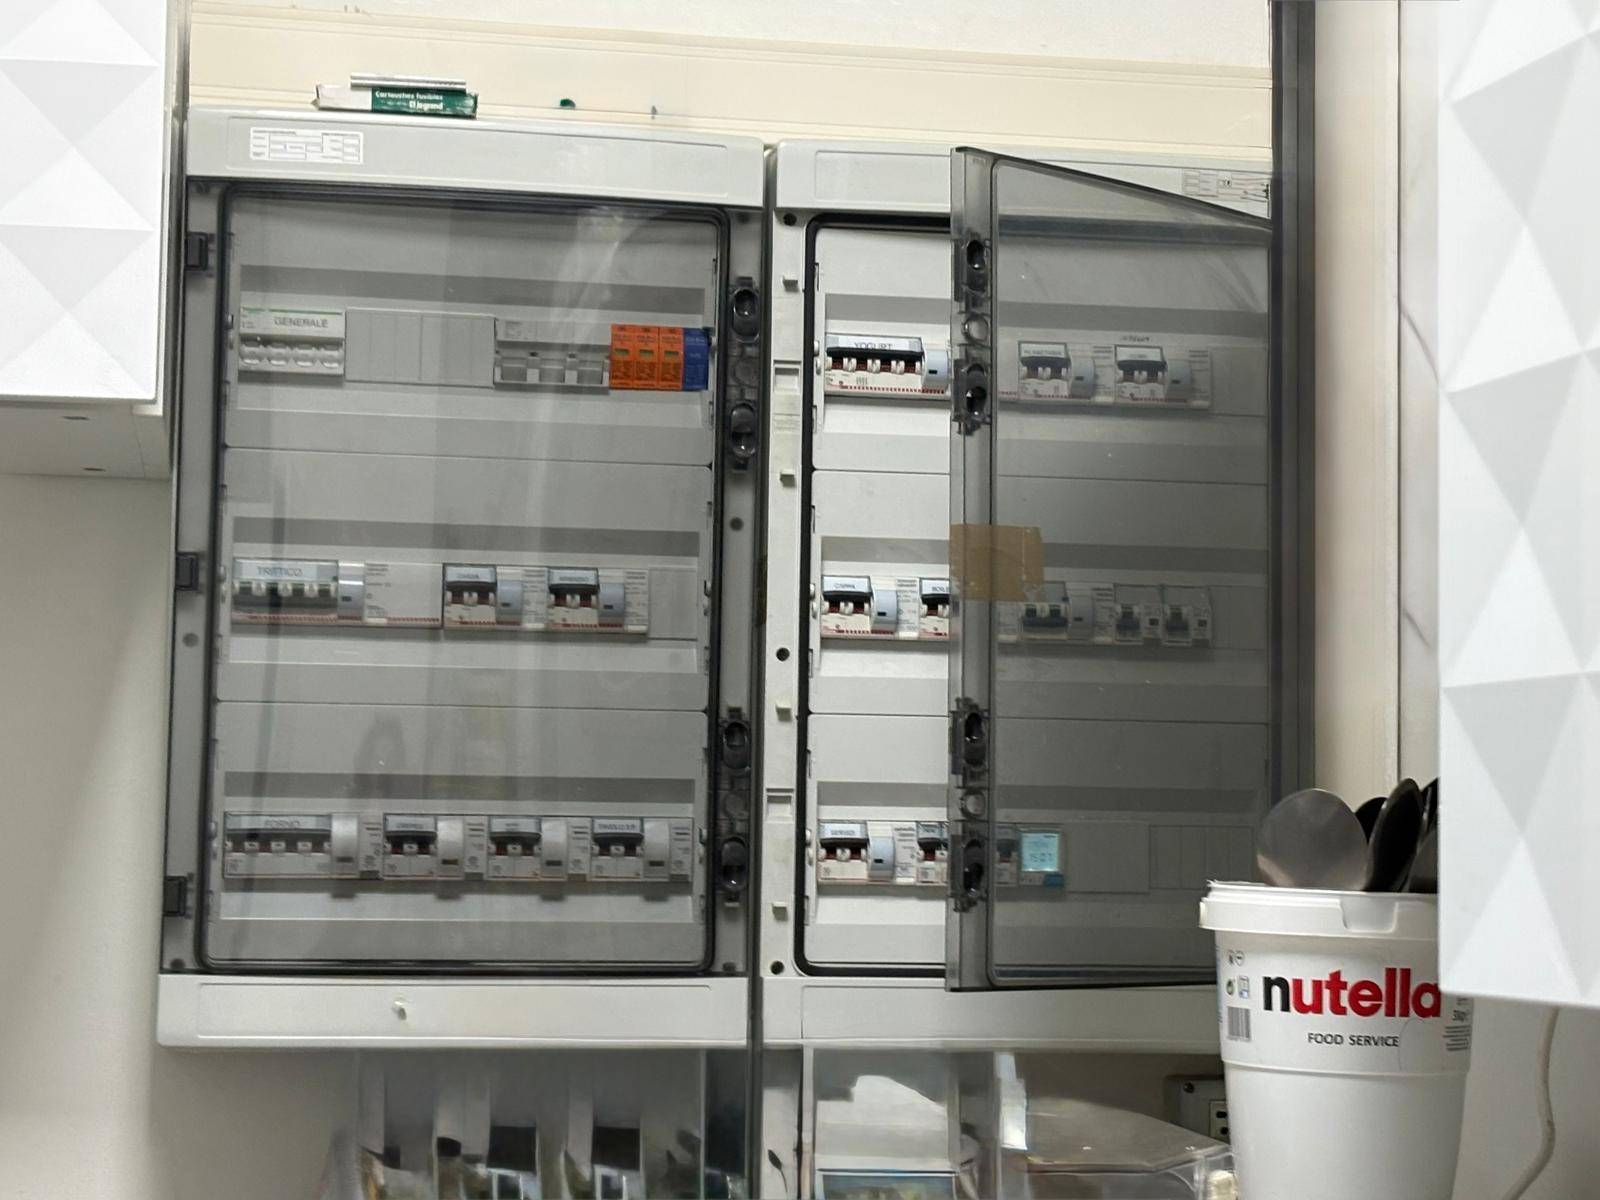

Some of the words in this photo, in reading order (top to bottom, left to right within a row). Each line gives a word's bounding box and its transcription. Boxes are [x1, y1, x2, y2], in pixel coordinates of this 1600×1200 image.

[274, 316, 329, 328] GENERALE
[854, 342, 893, 350] YOGURT
[1262, 967, 1441, 1018] nutella
[1307, 1032, 1344, 1045] FOOD
[1348, 1034, 1400, 1048] SERVICE
